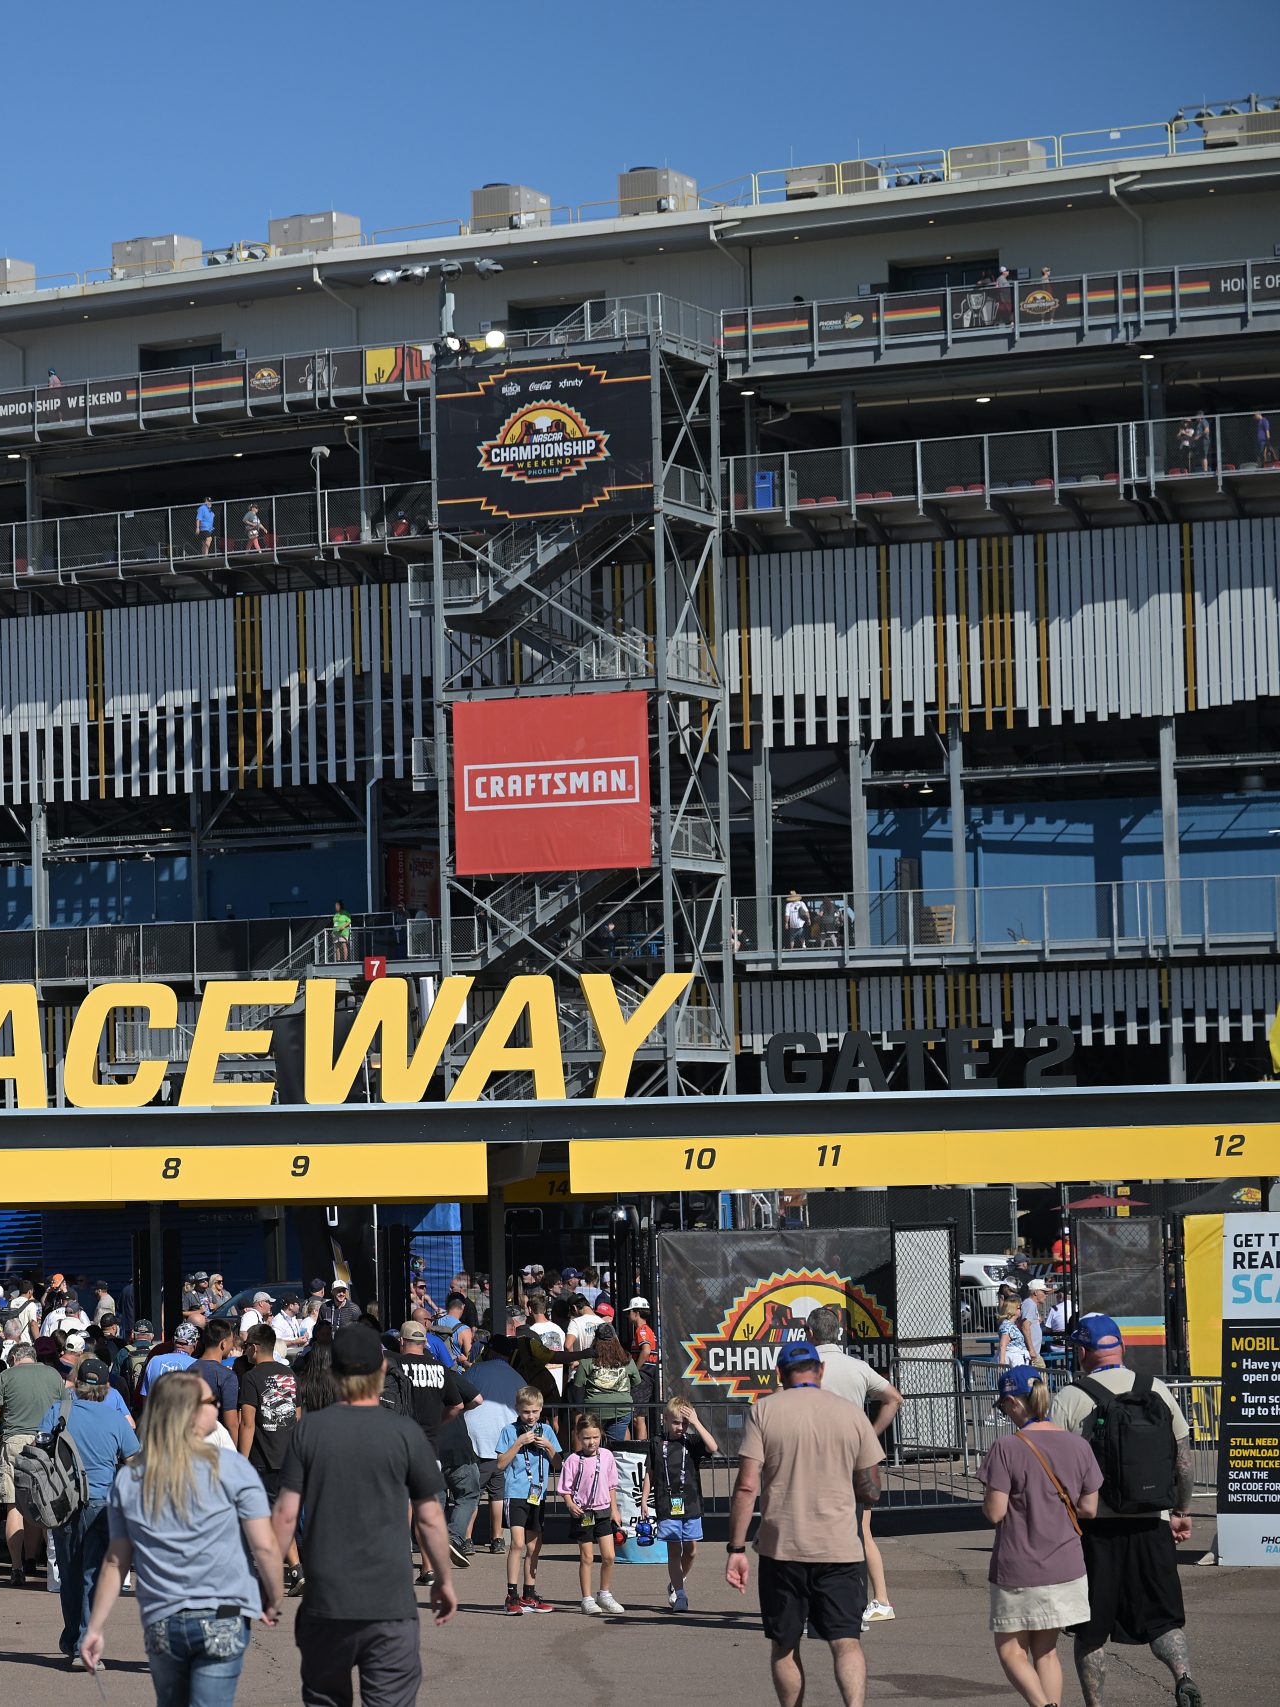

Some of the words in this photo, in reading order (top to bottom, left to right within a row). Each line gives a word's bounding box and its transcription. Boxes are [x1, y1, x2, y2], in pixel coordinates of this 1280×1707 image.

[558, 378, 583, 389] xfinity
[67, 391, 122, 409] WEEKEND
[532, 432, 564, 444] NASCAR
[491, 439, 596, 463] CHAMPIONSHIP
[516, 458, 571, 469] WEEKEND
[527, 467, 560, 476] PHOENIX
[475, 768, 626, 799] CRAFTSMAN
[370, 960, 380, 977] 7
[767, 1027, 999, 1095] GATE
[1023, 1025, 1077, 1089] 2
[1213, 1133, 1246, 1157] 12
[683, 1147, 717, 1171] 10
[816, 1144, 843, 1168] 11
[162, 1157, 182, 1180] 8
[290, 1155, 310, 1178] 9
[1233, 1233, 1265, 1248] GET
[1231, 1336, 1280, 1351] MOBIL
[1242, 1358, 1270, 1370] Have
[402, 1363, 445, 1389] LIONS
[1242, 1373, 1269, 1384] open
[1241, 1392, 1266, 1404] Turn
[1241, 1407, 1256, 1418] up
[1257, 1406, 1269, 1416] to
[1230, 1438, 1254, 1446] STILL
[1255, 1437, 1279, 1446] NEED
[1229, 1449, 1280, 1457] DOWNLOAD
[1229, 1460, 1253, 1468] YOUR
[1255, 1459, 1280, 1468] TICKE
[1228, 1471, 1251, 1479] SCAN
[1252, 1471, 1269, 1479] THE
[1228, 1482, 1240, 1491] QR
[1241, 1482, 1263, 1491] CODE
